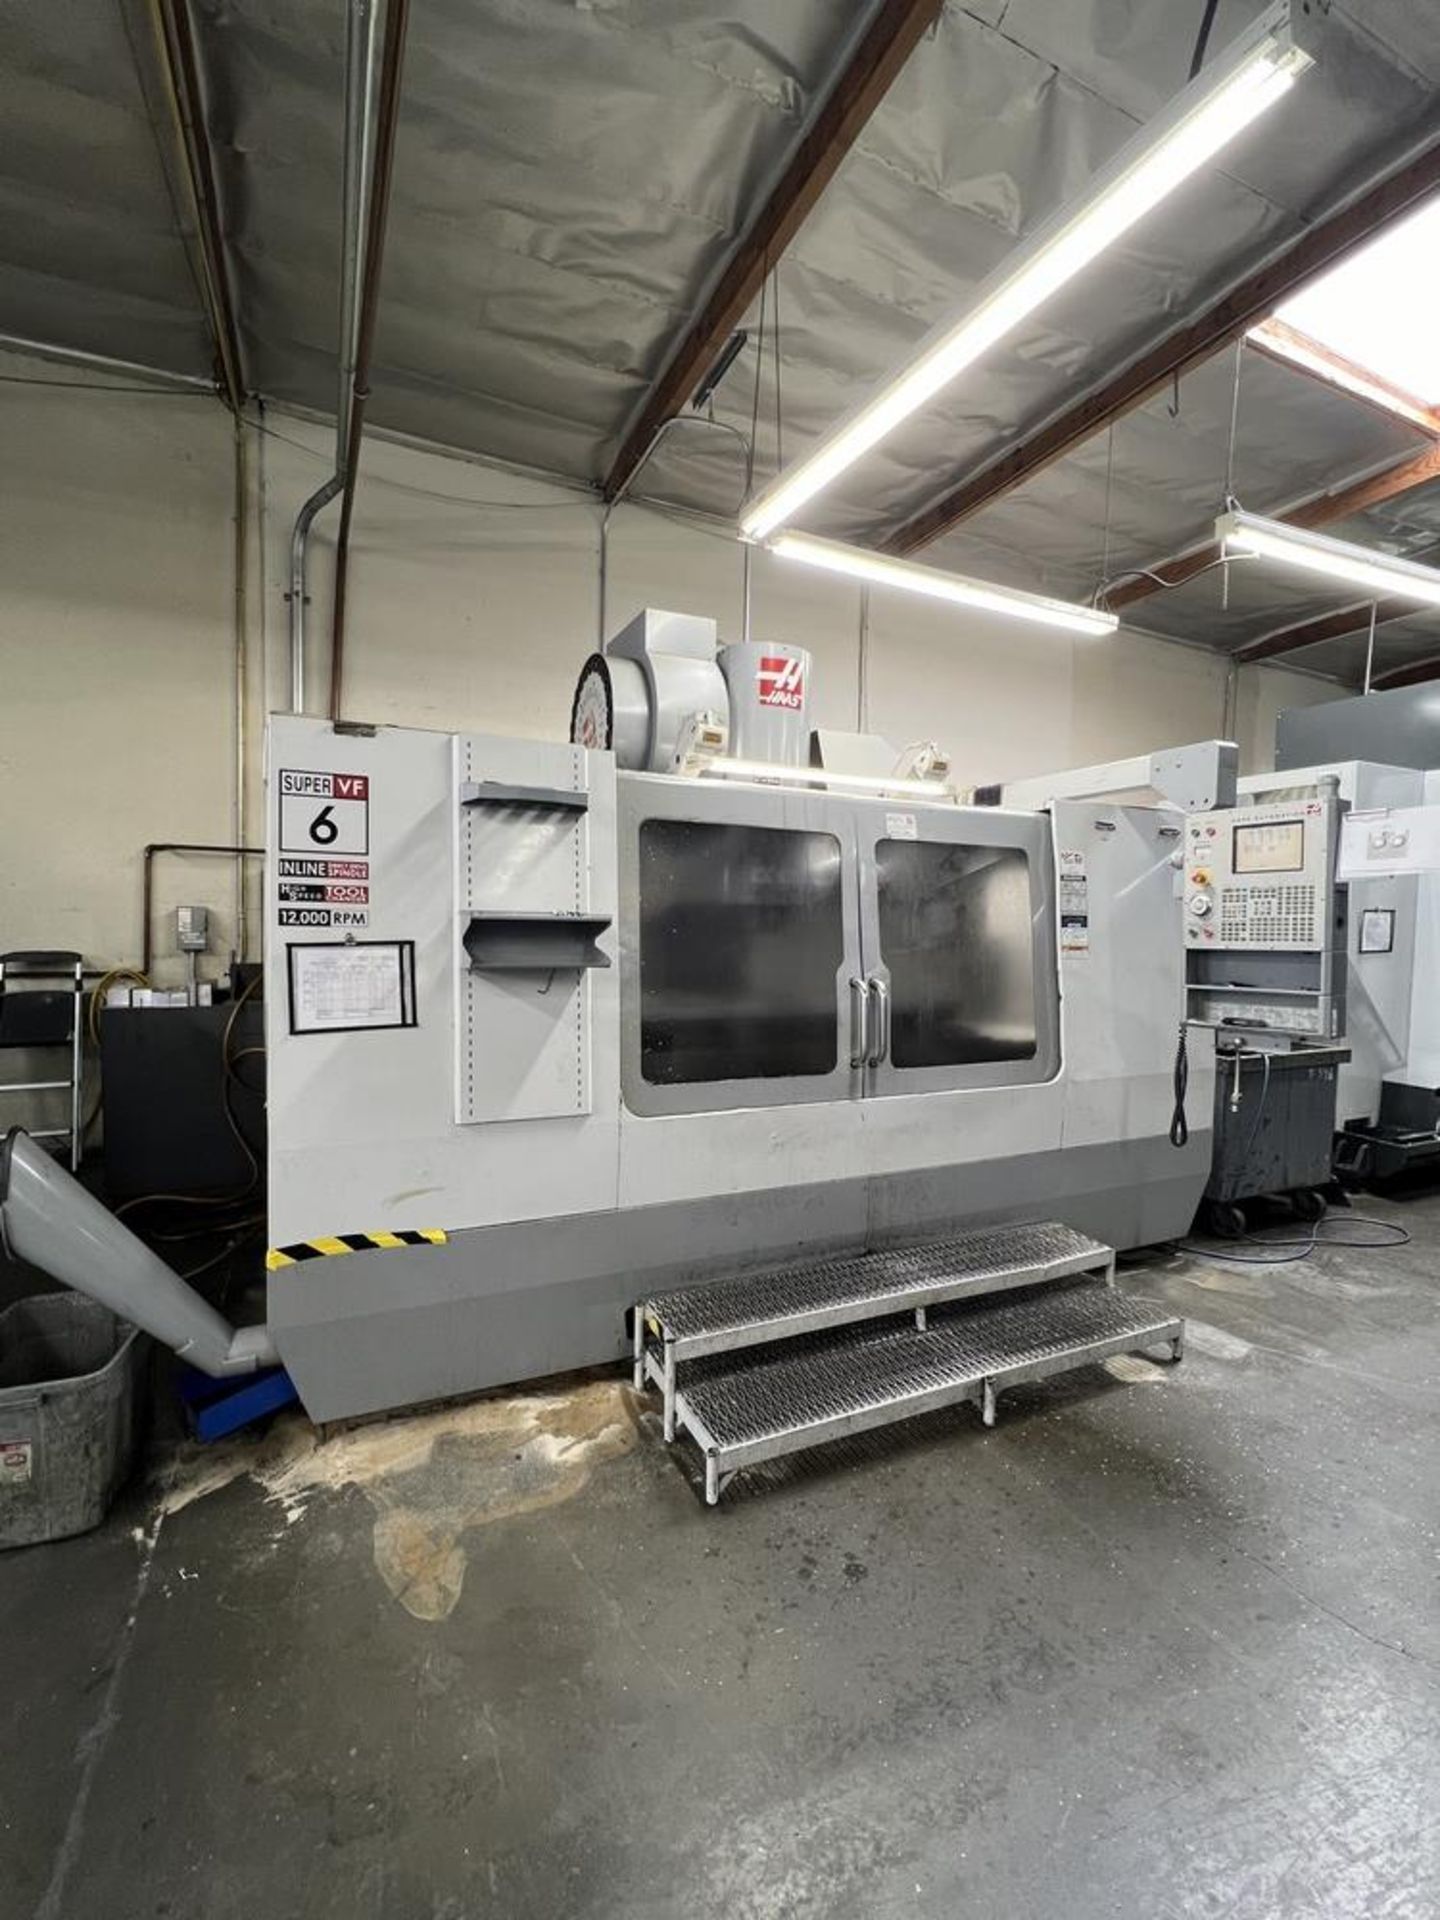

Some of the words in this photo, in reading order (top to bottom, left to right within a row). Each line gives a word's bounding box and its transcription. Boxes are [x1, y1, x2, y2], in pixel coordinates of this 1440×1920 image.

[284, 774, 331, 793] SUPER
[337, 778, 364, 796] VF
[309, 806, 338, 845] 6
[279, 861, 327, 877] INLINE
[326, 886, 367, 898] TOOL
[333, 911, 366, 925] RPM
